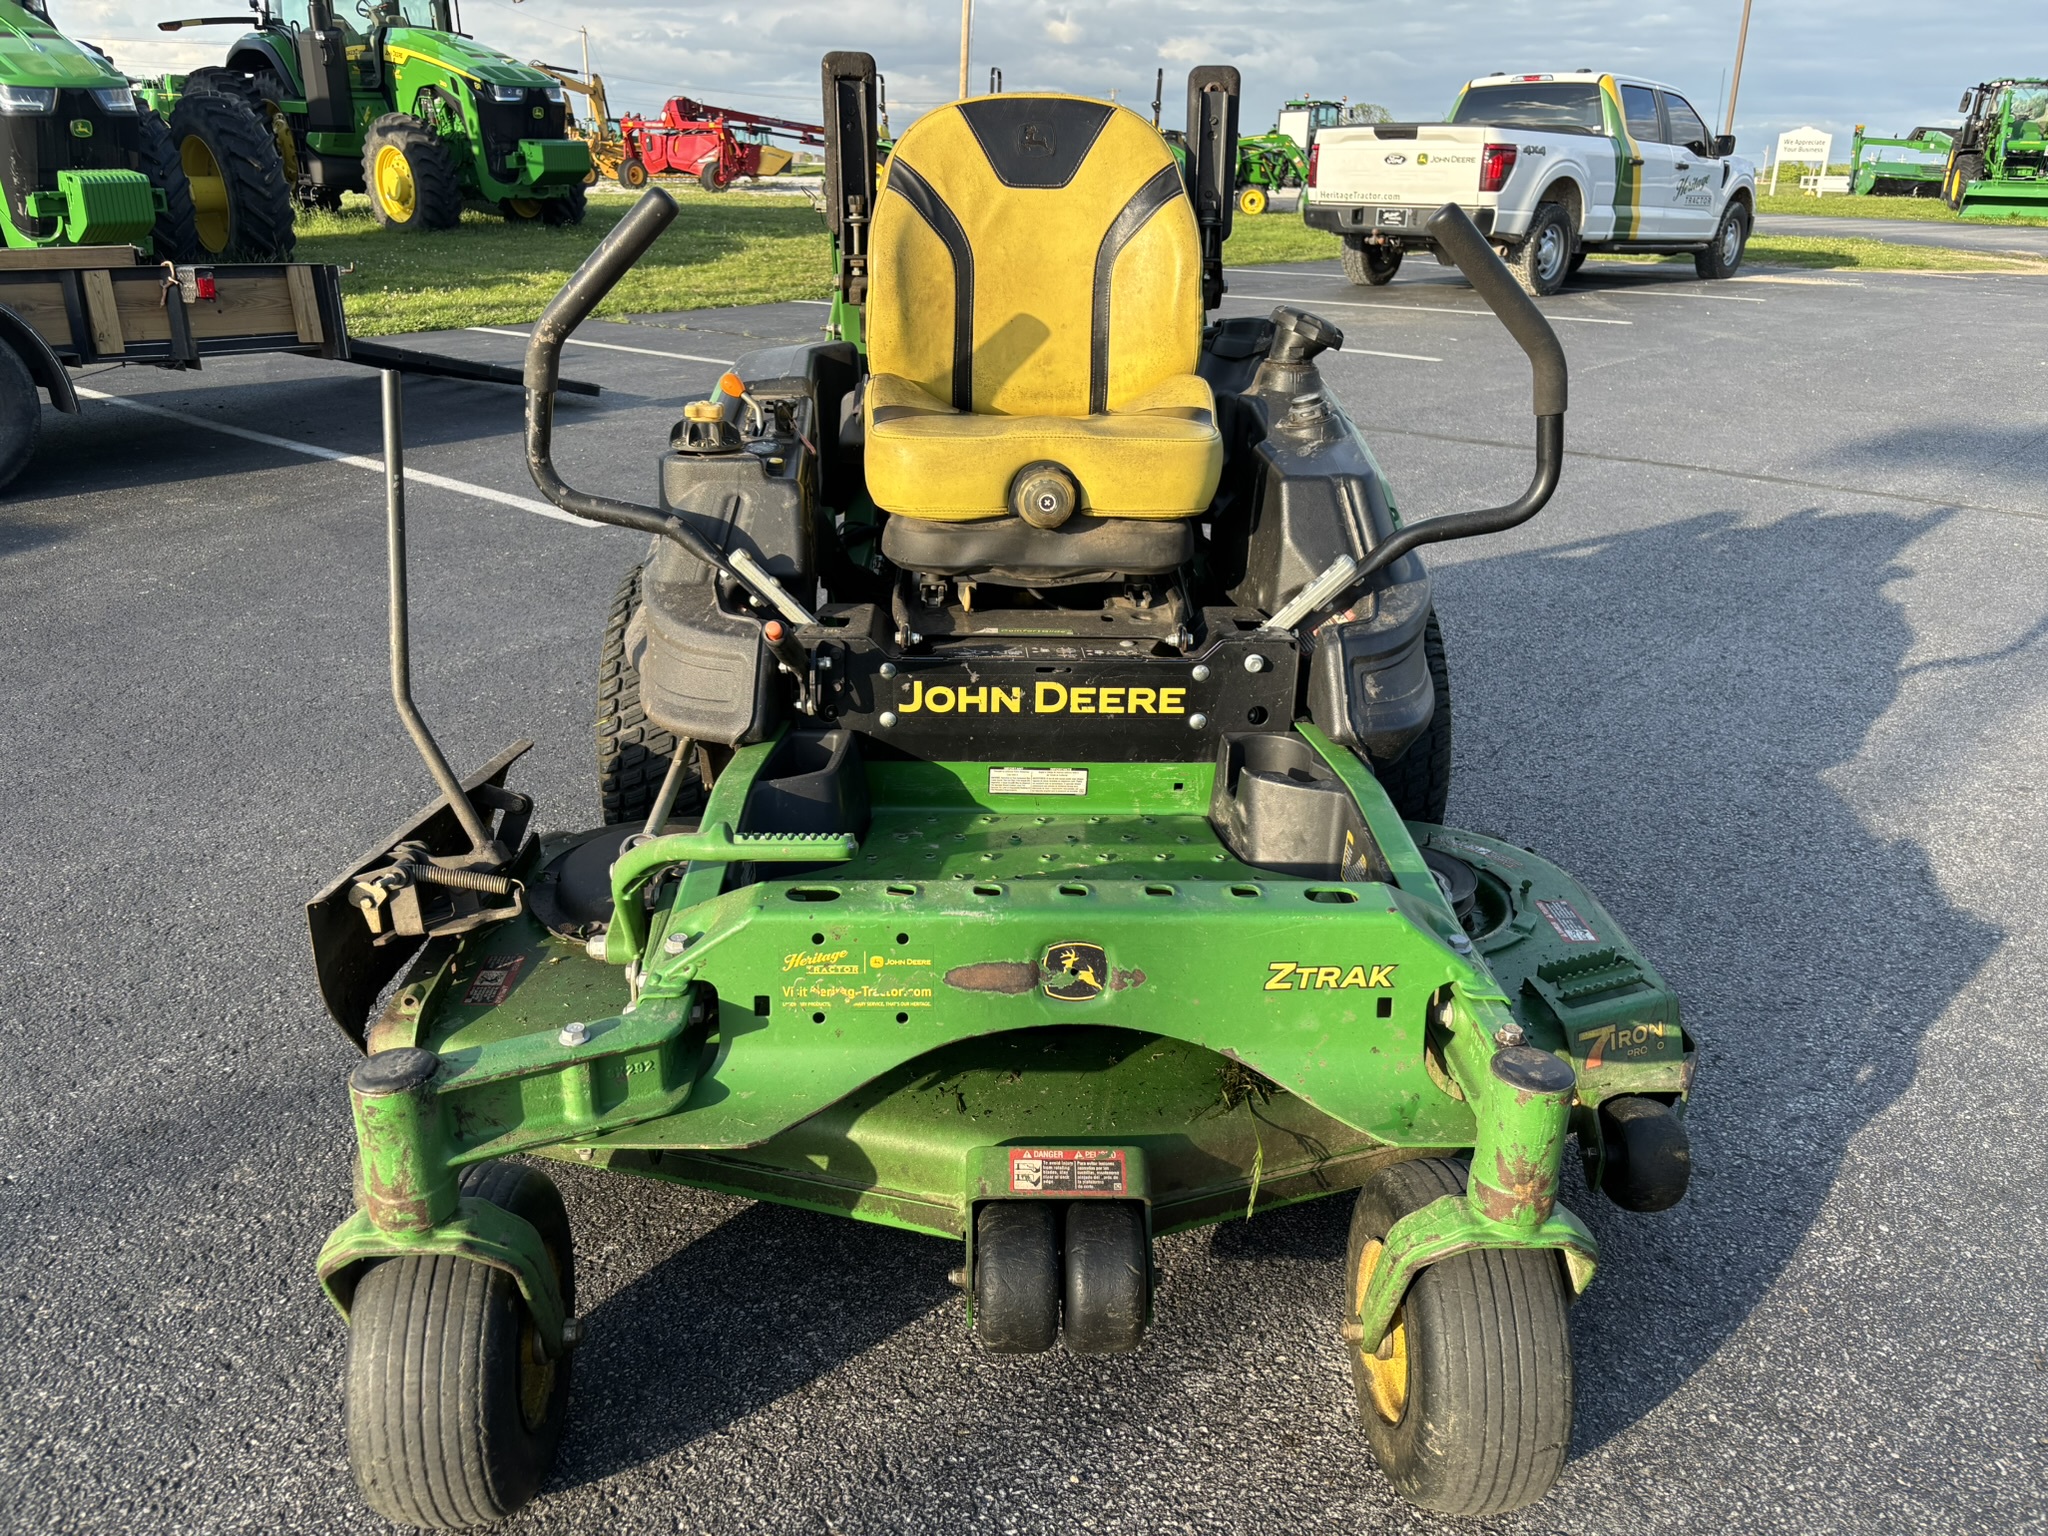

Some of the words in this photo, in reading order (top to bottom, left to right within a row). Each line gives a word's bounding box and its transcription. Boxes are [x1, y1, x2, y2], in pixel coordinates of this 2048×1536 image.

[1430, 156, 1450, 164] JOHN
[1451, 155, 1476, 164] DEERE
[1320, 190, 1401, 201] HeritageTractor.com
[1673, 174, 1710, 201] Heritage
[1685, 196, 1711, 204] TRACTOR
[898, 680, 1021, 713] JOHN
[1035, 681, 1187, 714] DEERE
[782, 949, 849, 972] Heritage
[885, 958, 906, 966] JOHN
[907, 958, 932, 966] DEERE
[1263, 961, 1400, 991] ZTRAK
[1610, 1020, 1664, 1051] IRON
[1033, 1151, 1064, 1159] DANGER
